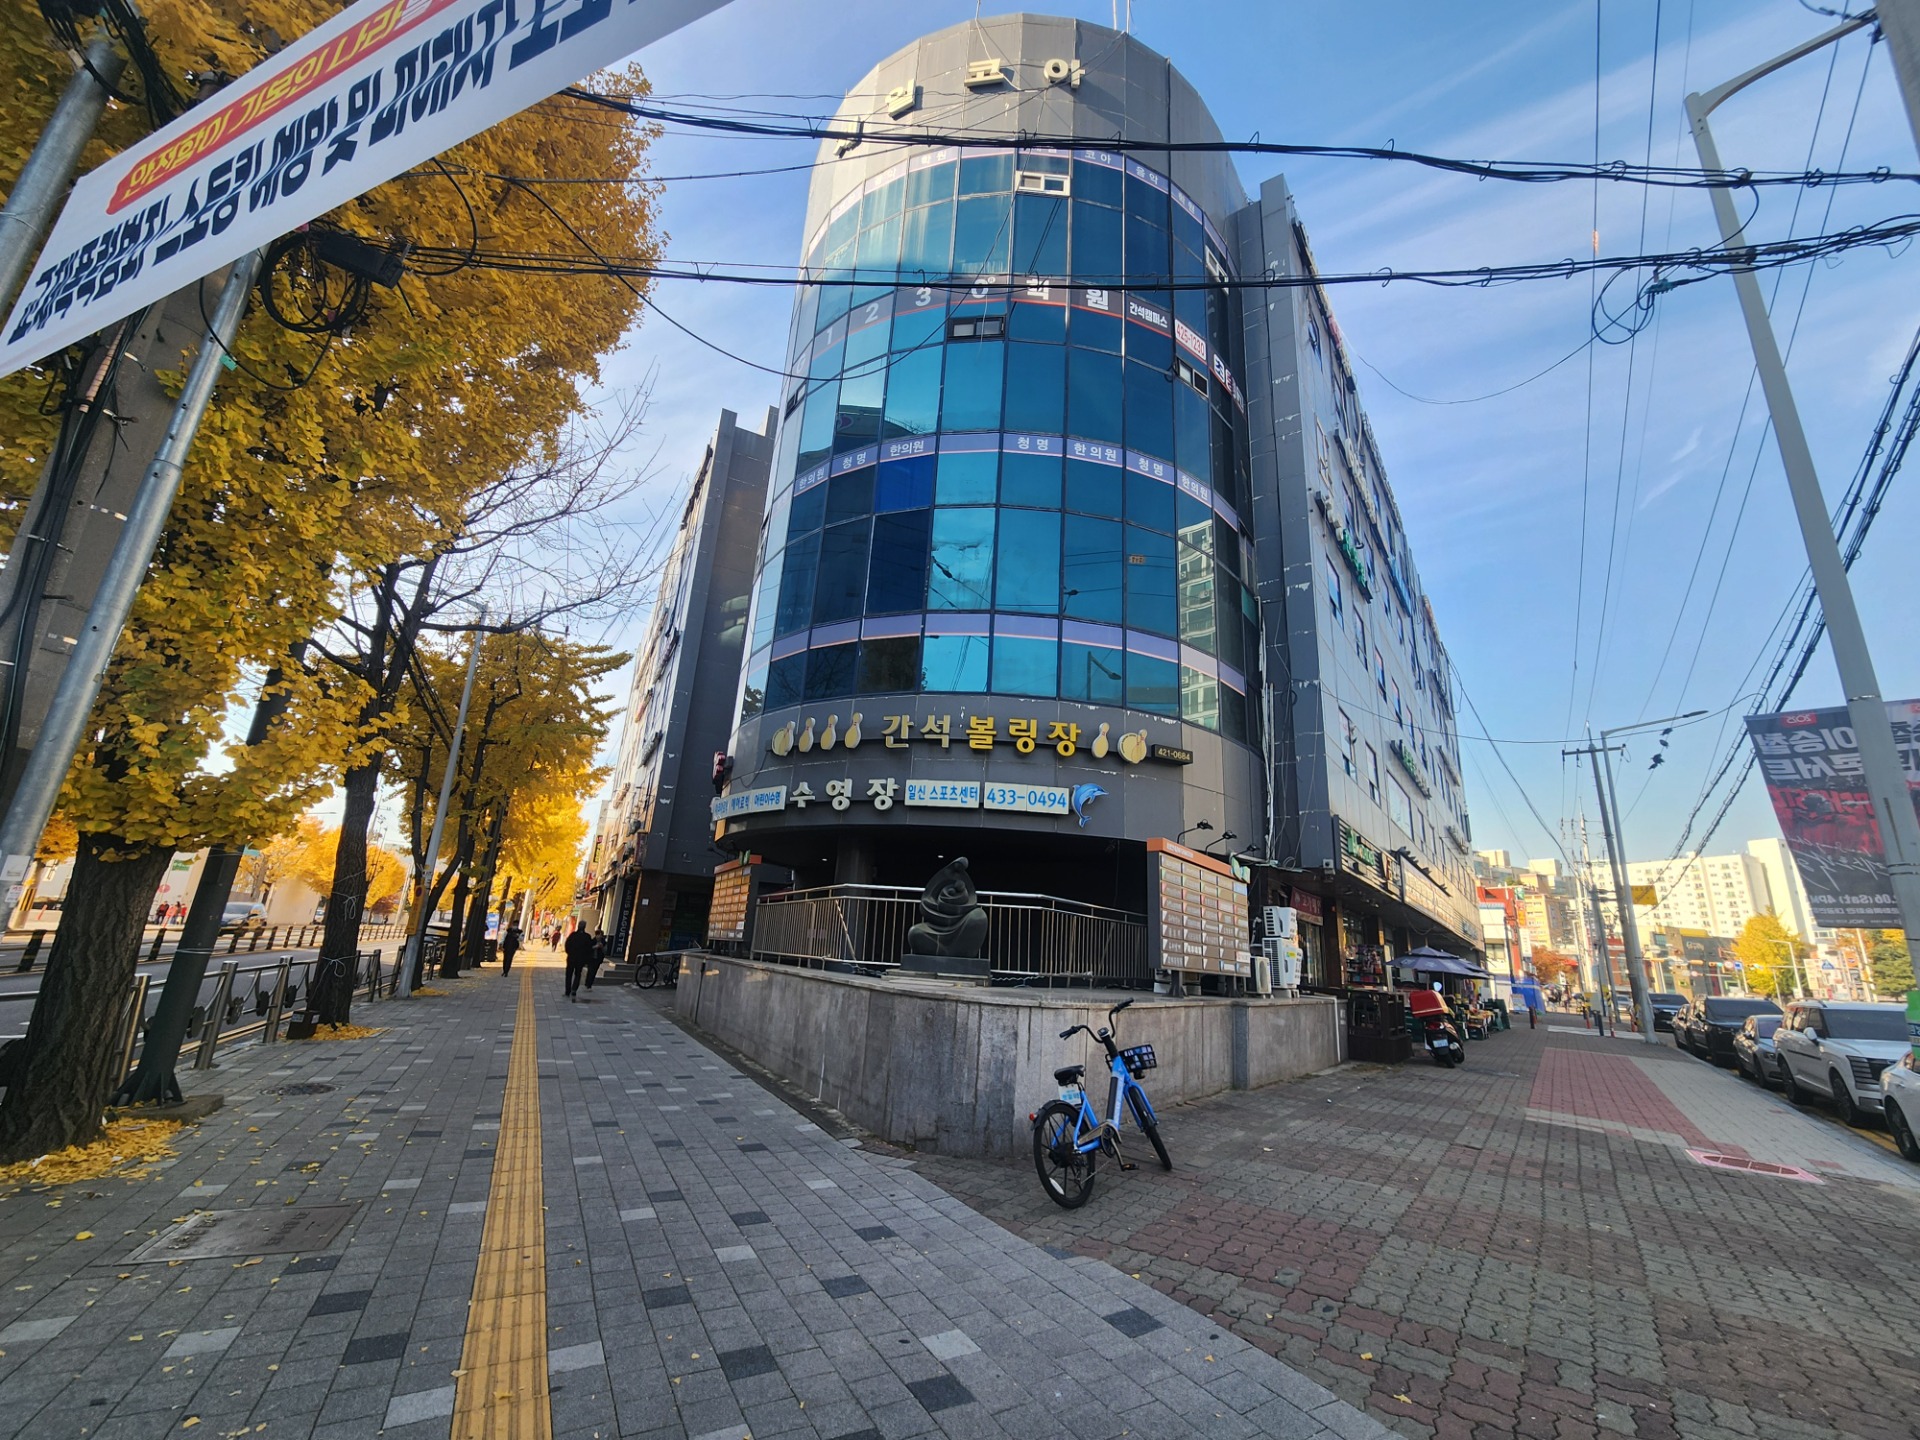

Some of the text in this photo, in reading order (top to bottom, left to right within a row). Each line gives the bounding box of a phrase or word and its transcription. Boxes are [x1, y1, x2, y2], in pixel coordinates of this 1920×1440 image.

[248, 95, 340, 214] 예방
[320, 66, 385, 178] 및
[368, 0, 521, 148] 피해자
[122, 113, 231, 202] 안전함이
[227, 46, 331, 135] 기본인
[1135, 166, 1159, 185] 음악
[1129, 301, 1168, 329] 간석캠퍼스
[1176, 324, 1206, 359] 425-1230
[842, 440, 925, 470] 청명 한의원
[1017, 436, 1209, 502] 청명 한의원 청명 한의원
[1158, 747, 1191, 761] 421-0684
[789, 777, 901, 812] 수영장
[907, 782, 979, 805] 일신 스포츠센터
[986, 788, 1068, 808] 433-0494
[616, 909, 630, 953] BAGUETTE
